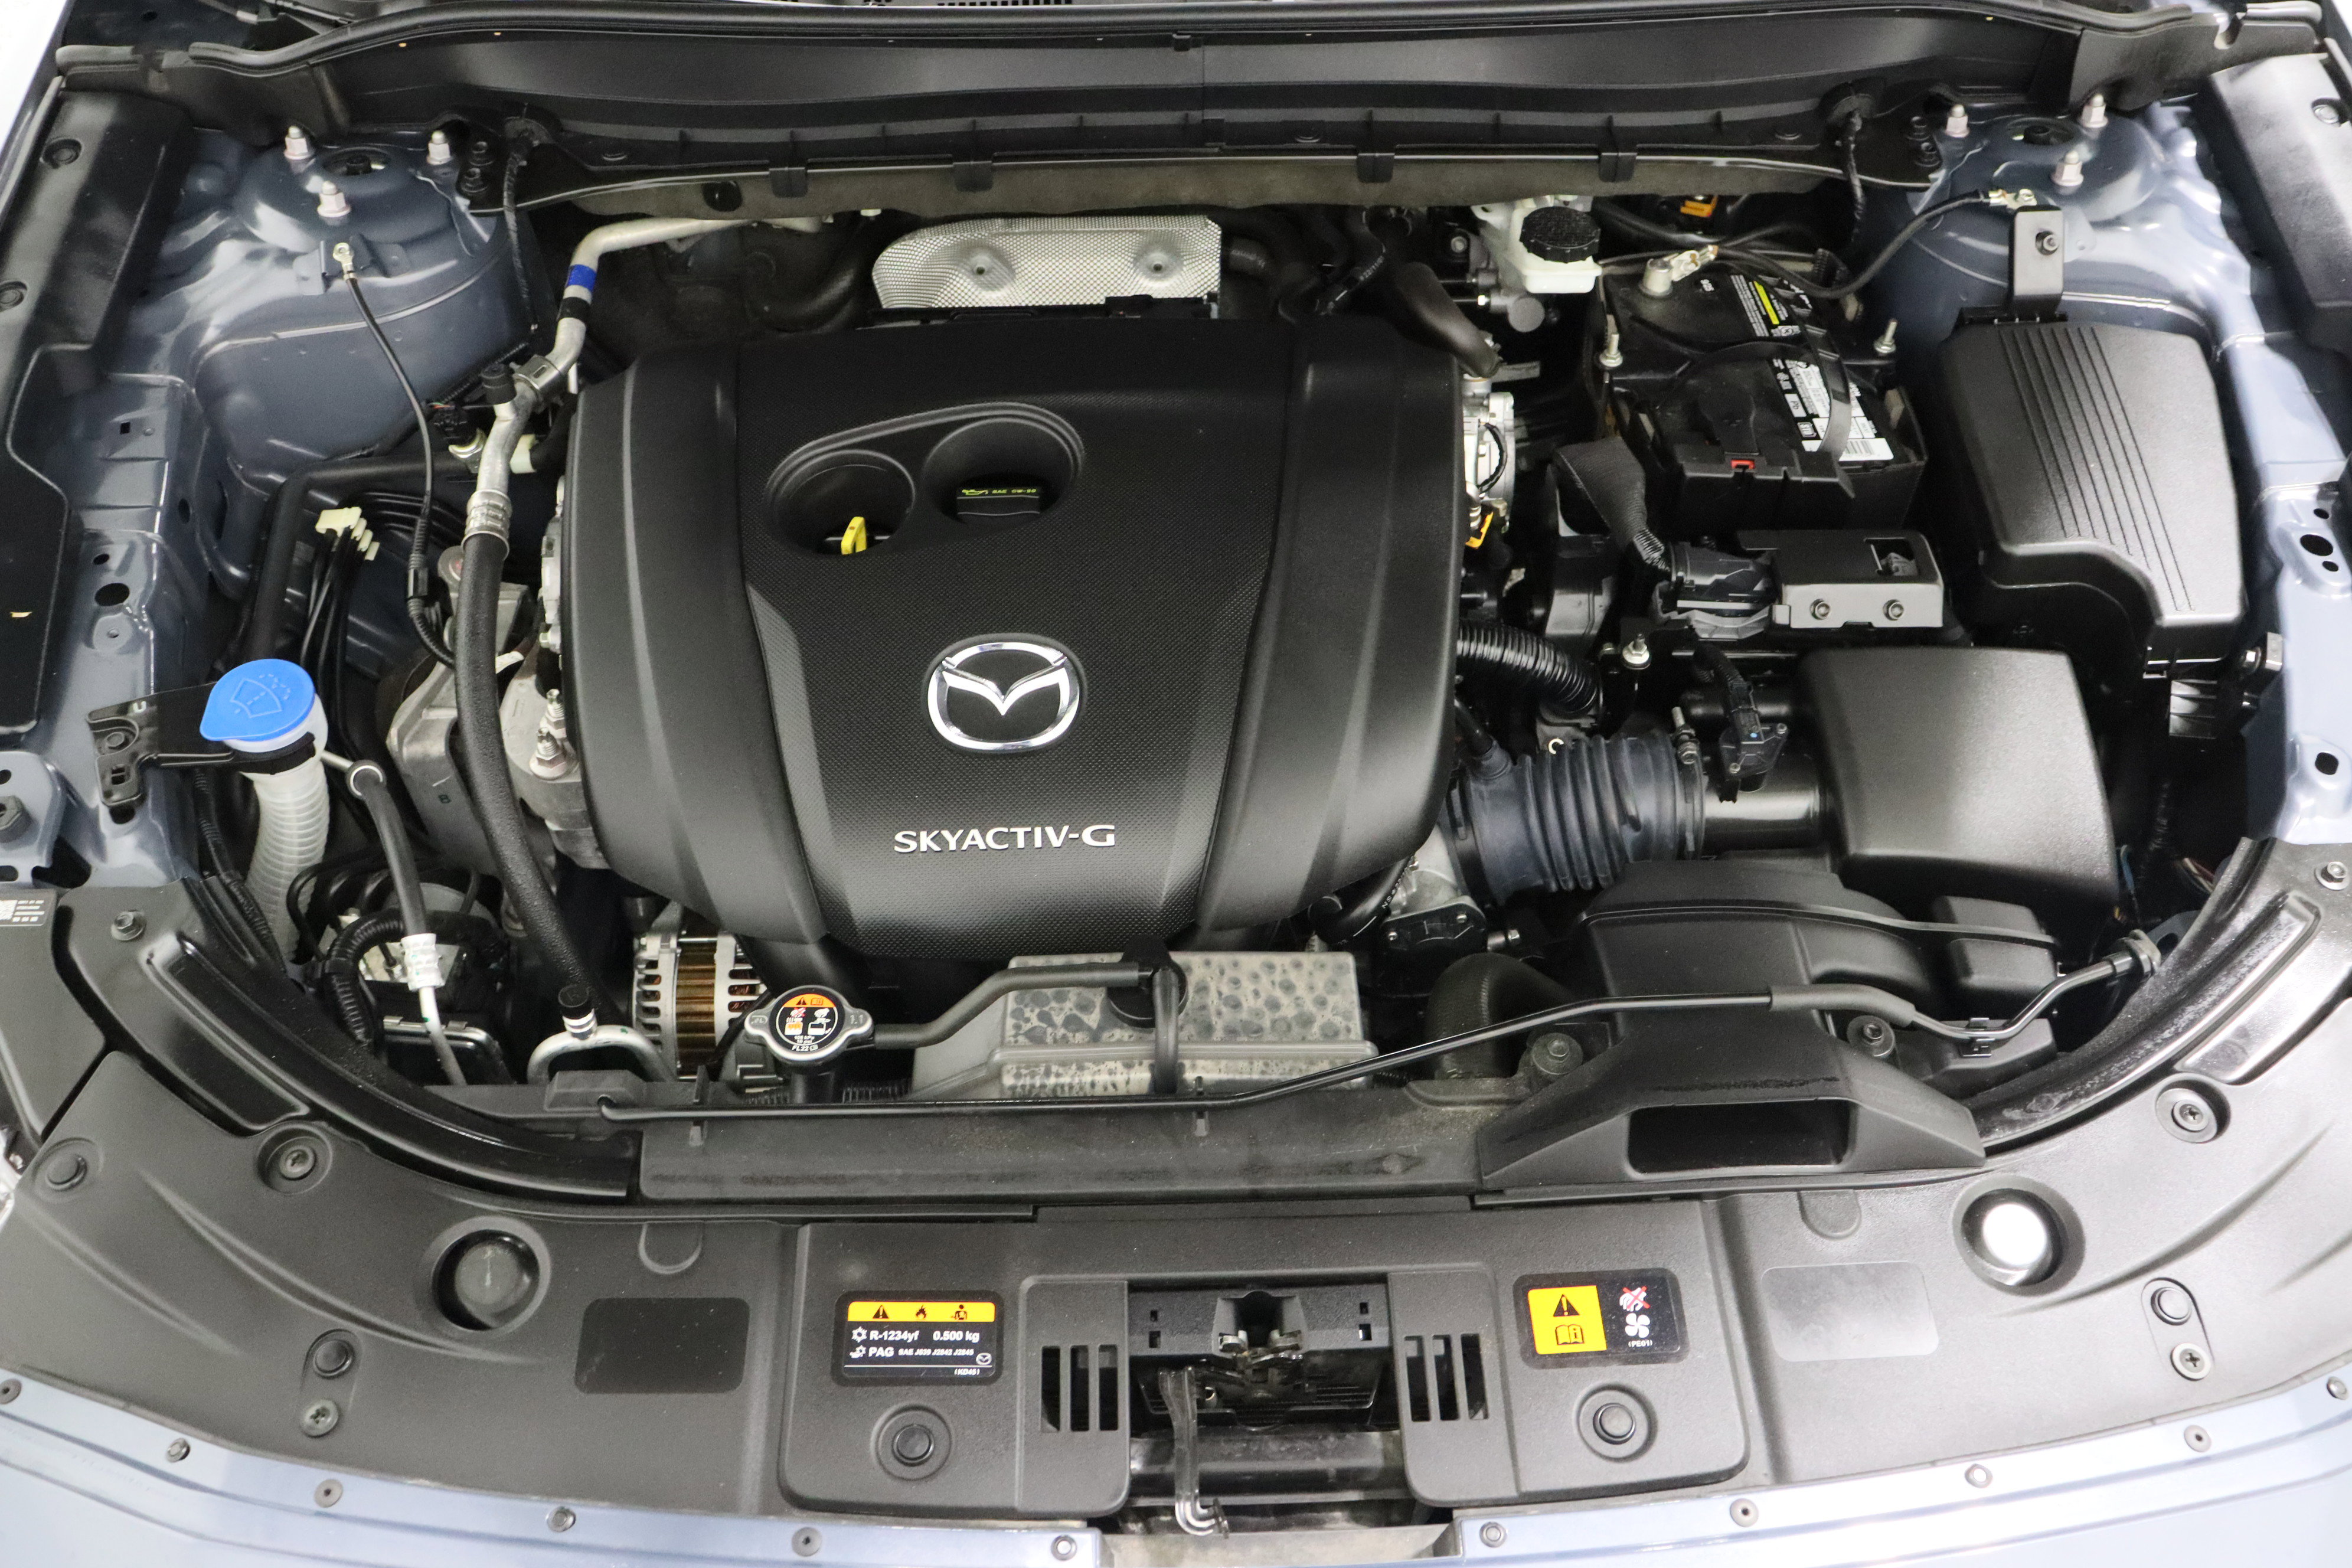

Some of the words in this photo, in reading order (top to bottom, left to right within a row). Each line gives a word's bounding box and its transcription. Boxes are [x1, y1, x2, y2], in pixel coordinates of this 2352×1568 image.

[894, 824, 1116, 853] SKYACTIV-G
[870, 1330, 919, 1343] R-1234yf
[933, 1331, 963, 1341] 0.500
[965, 1330, 980, 1343] kg
[868, 1347, 894, 1357] PAG
